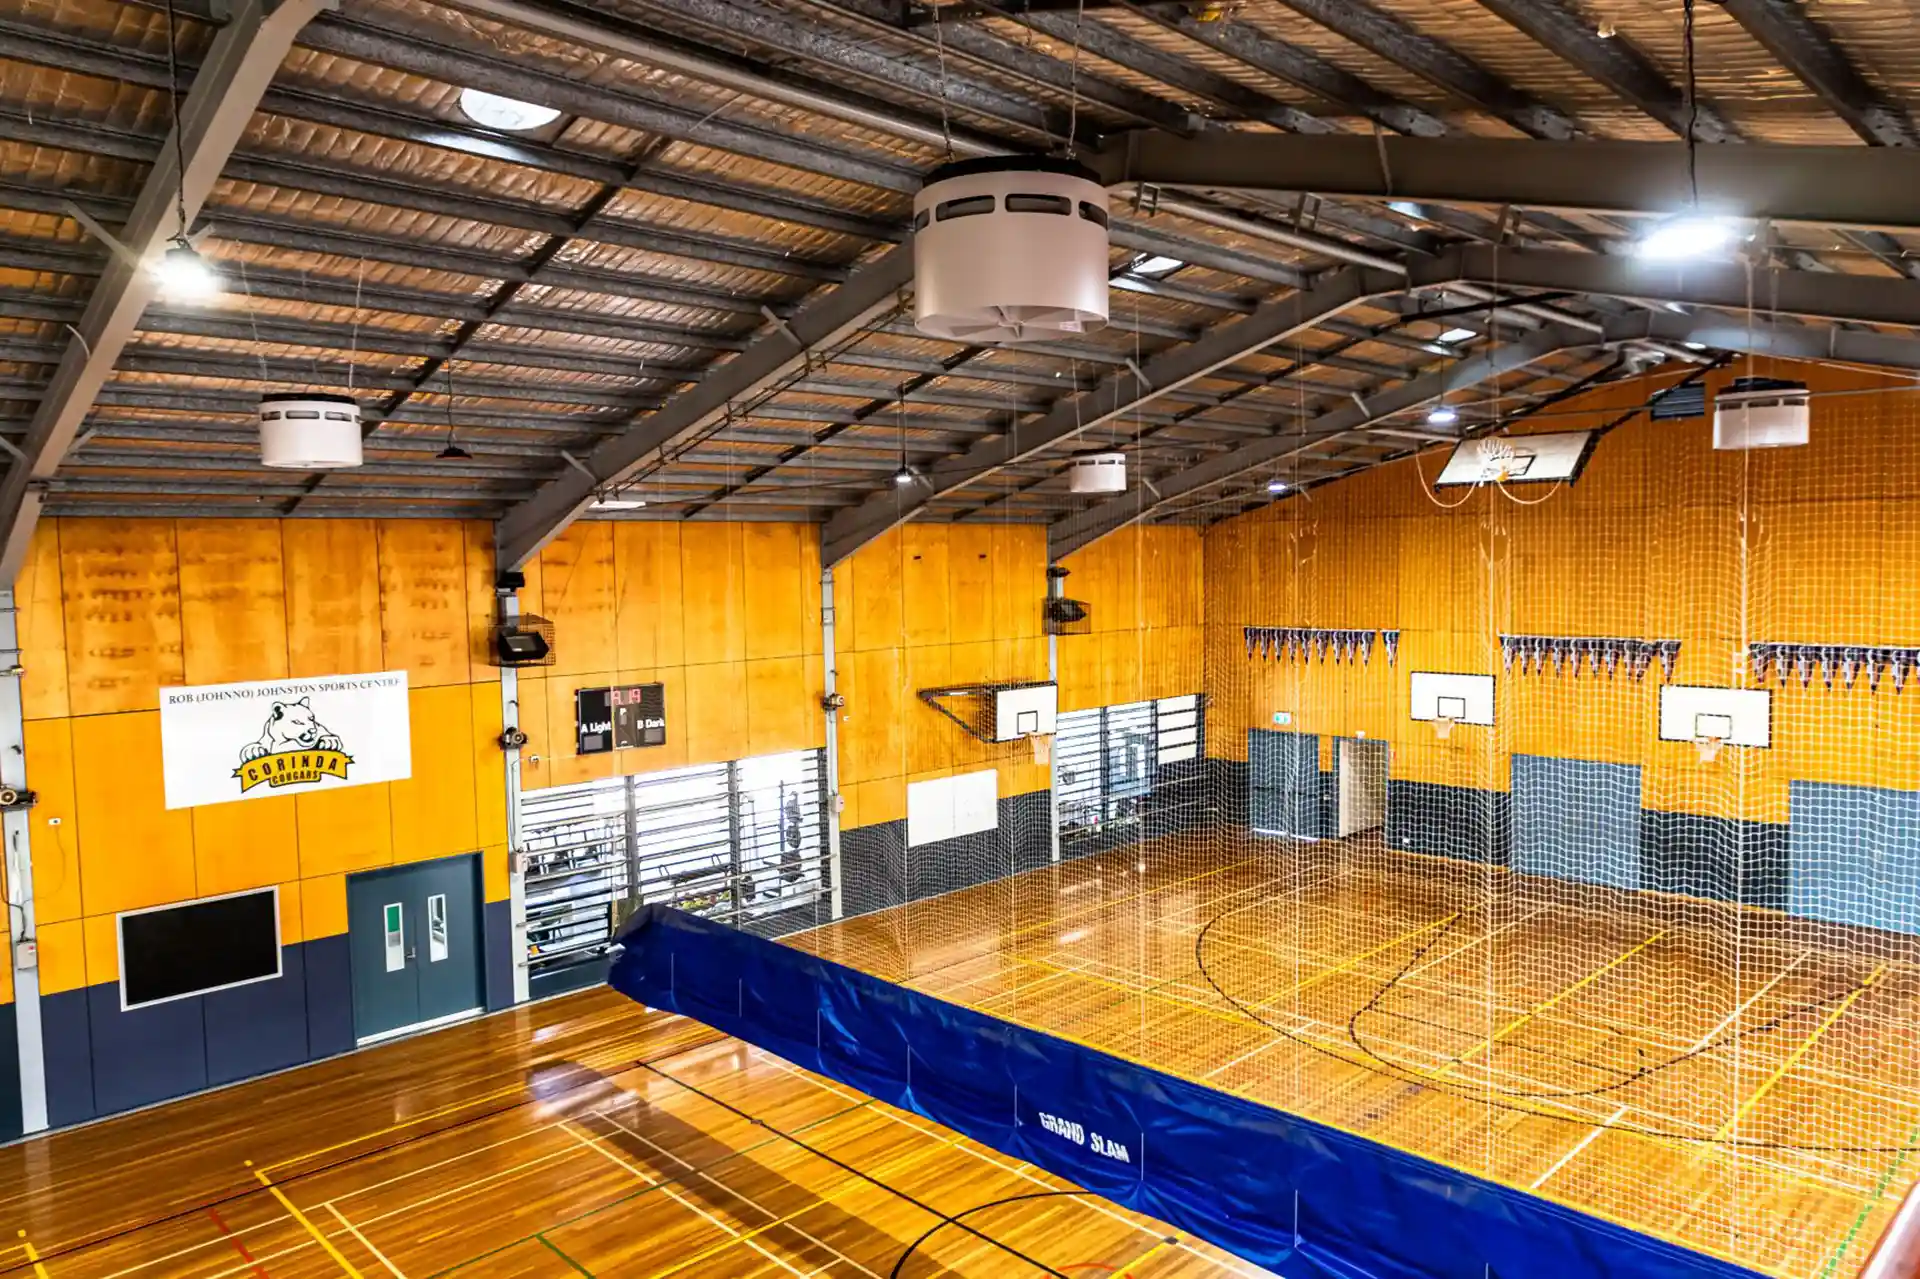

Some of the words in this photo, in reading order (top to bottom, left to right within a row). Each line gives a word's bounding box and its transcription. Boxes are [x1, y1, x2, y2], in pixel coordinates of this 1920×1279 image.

[169, 694, 194, 705] ROB
[196, 689, 254, 703] (JOHNNO)
[256, 684, 316, 697] JOHNSTON
[318, 681, 358, 692] SPORTS
[360, 678, 400, 689] CENTRE
[581, 724, 588, 733] A
[590, 722, 611, 733] Light
[637, 720, 644, 729] B
[645, 719, 664, 728] Dark
[247, 755, 338, 781] CORINDA
[271, 770, 318, 785] COUGARS
[1038, 1111, 1085, 1146] GRAND
[1090, 1132, 1130, 1163] SLAM
